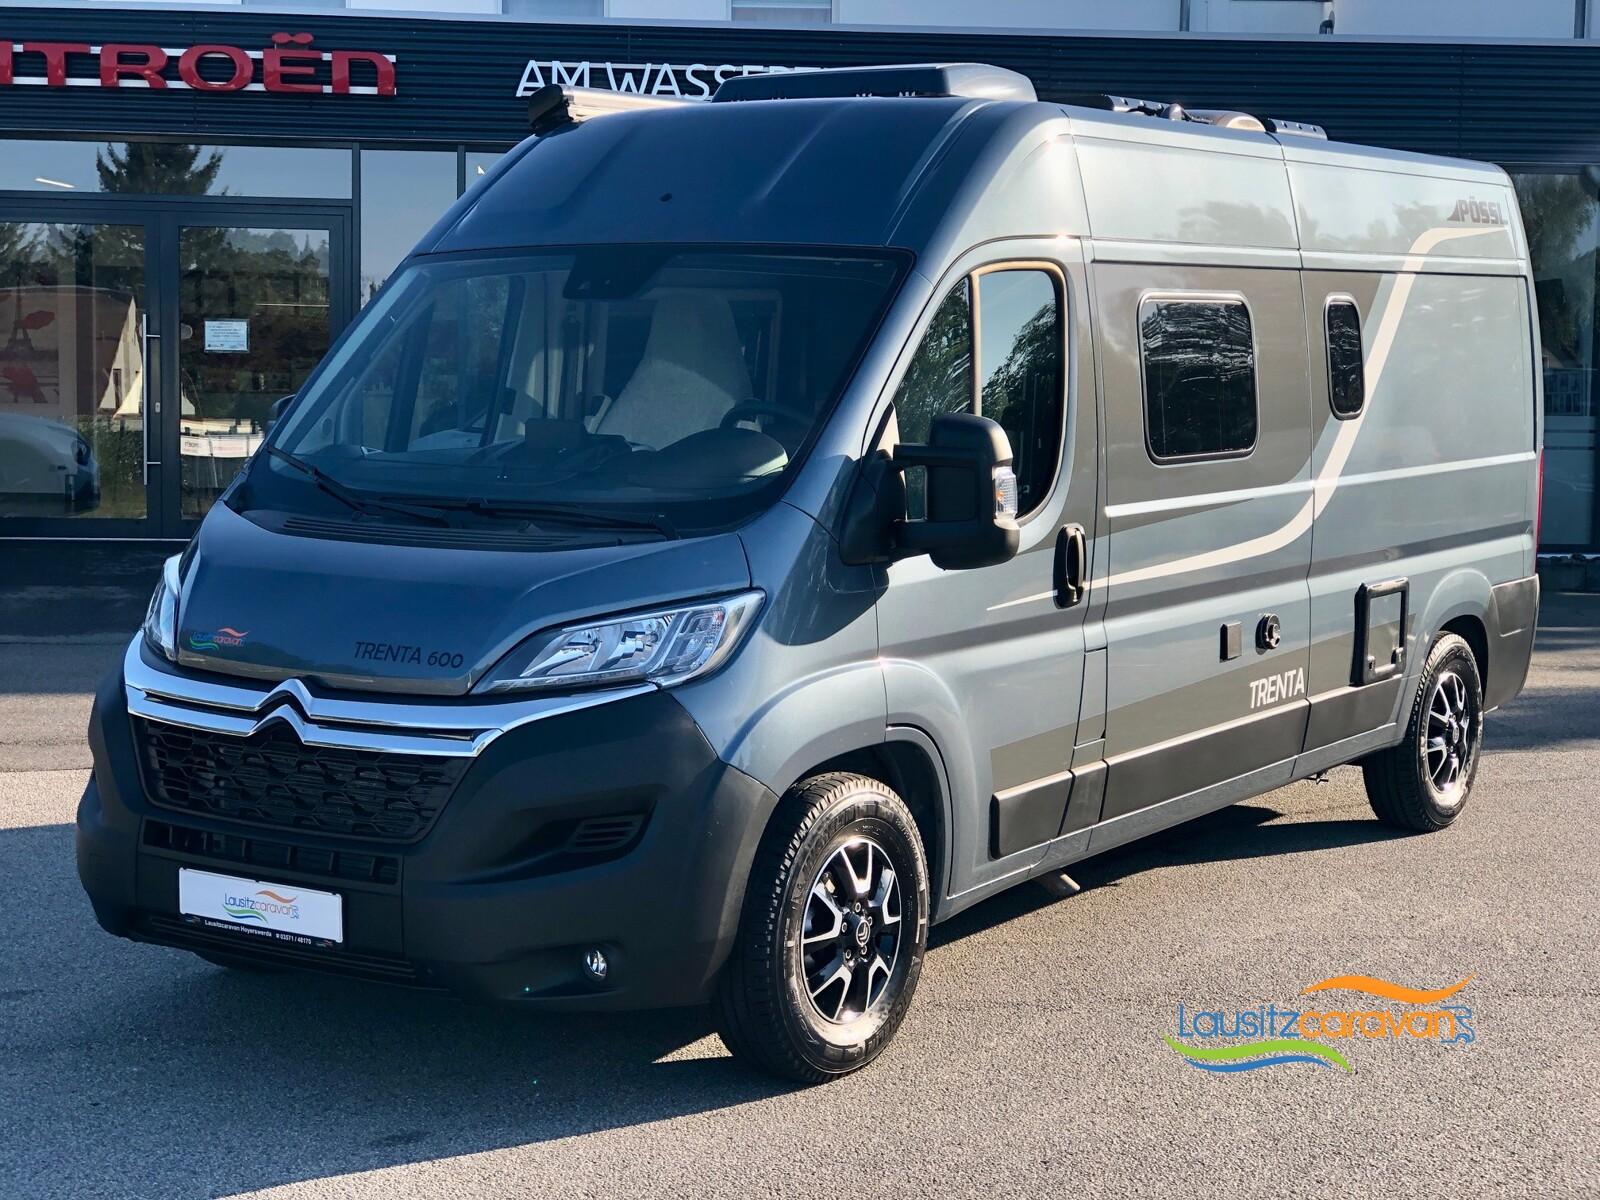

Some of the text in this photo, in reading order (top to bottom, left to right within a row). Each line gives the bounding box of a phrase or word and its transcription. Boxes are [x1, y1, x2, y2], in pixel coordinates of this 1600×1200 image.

[516, 60, 590, 97] AM
[1457, 195, 1508, 225] PÖSSL
[354, 641, 464, 669] TRENTA 600
[1250, 667, 1305, 709] TRENTA
